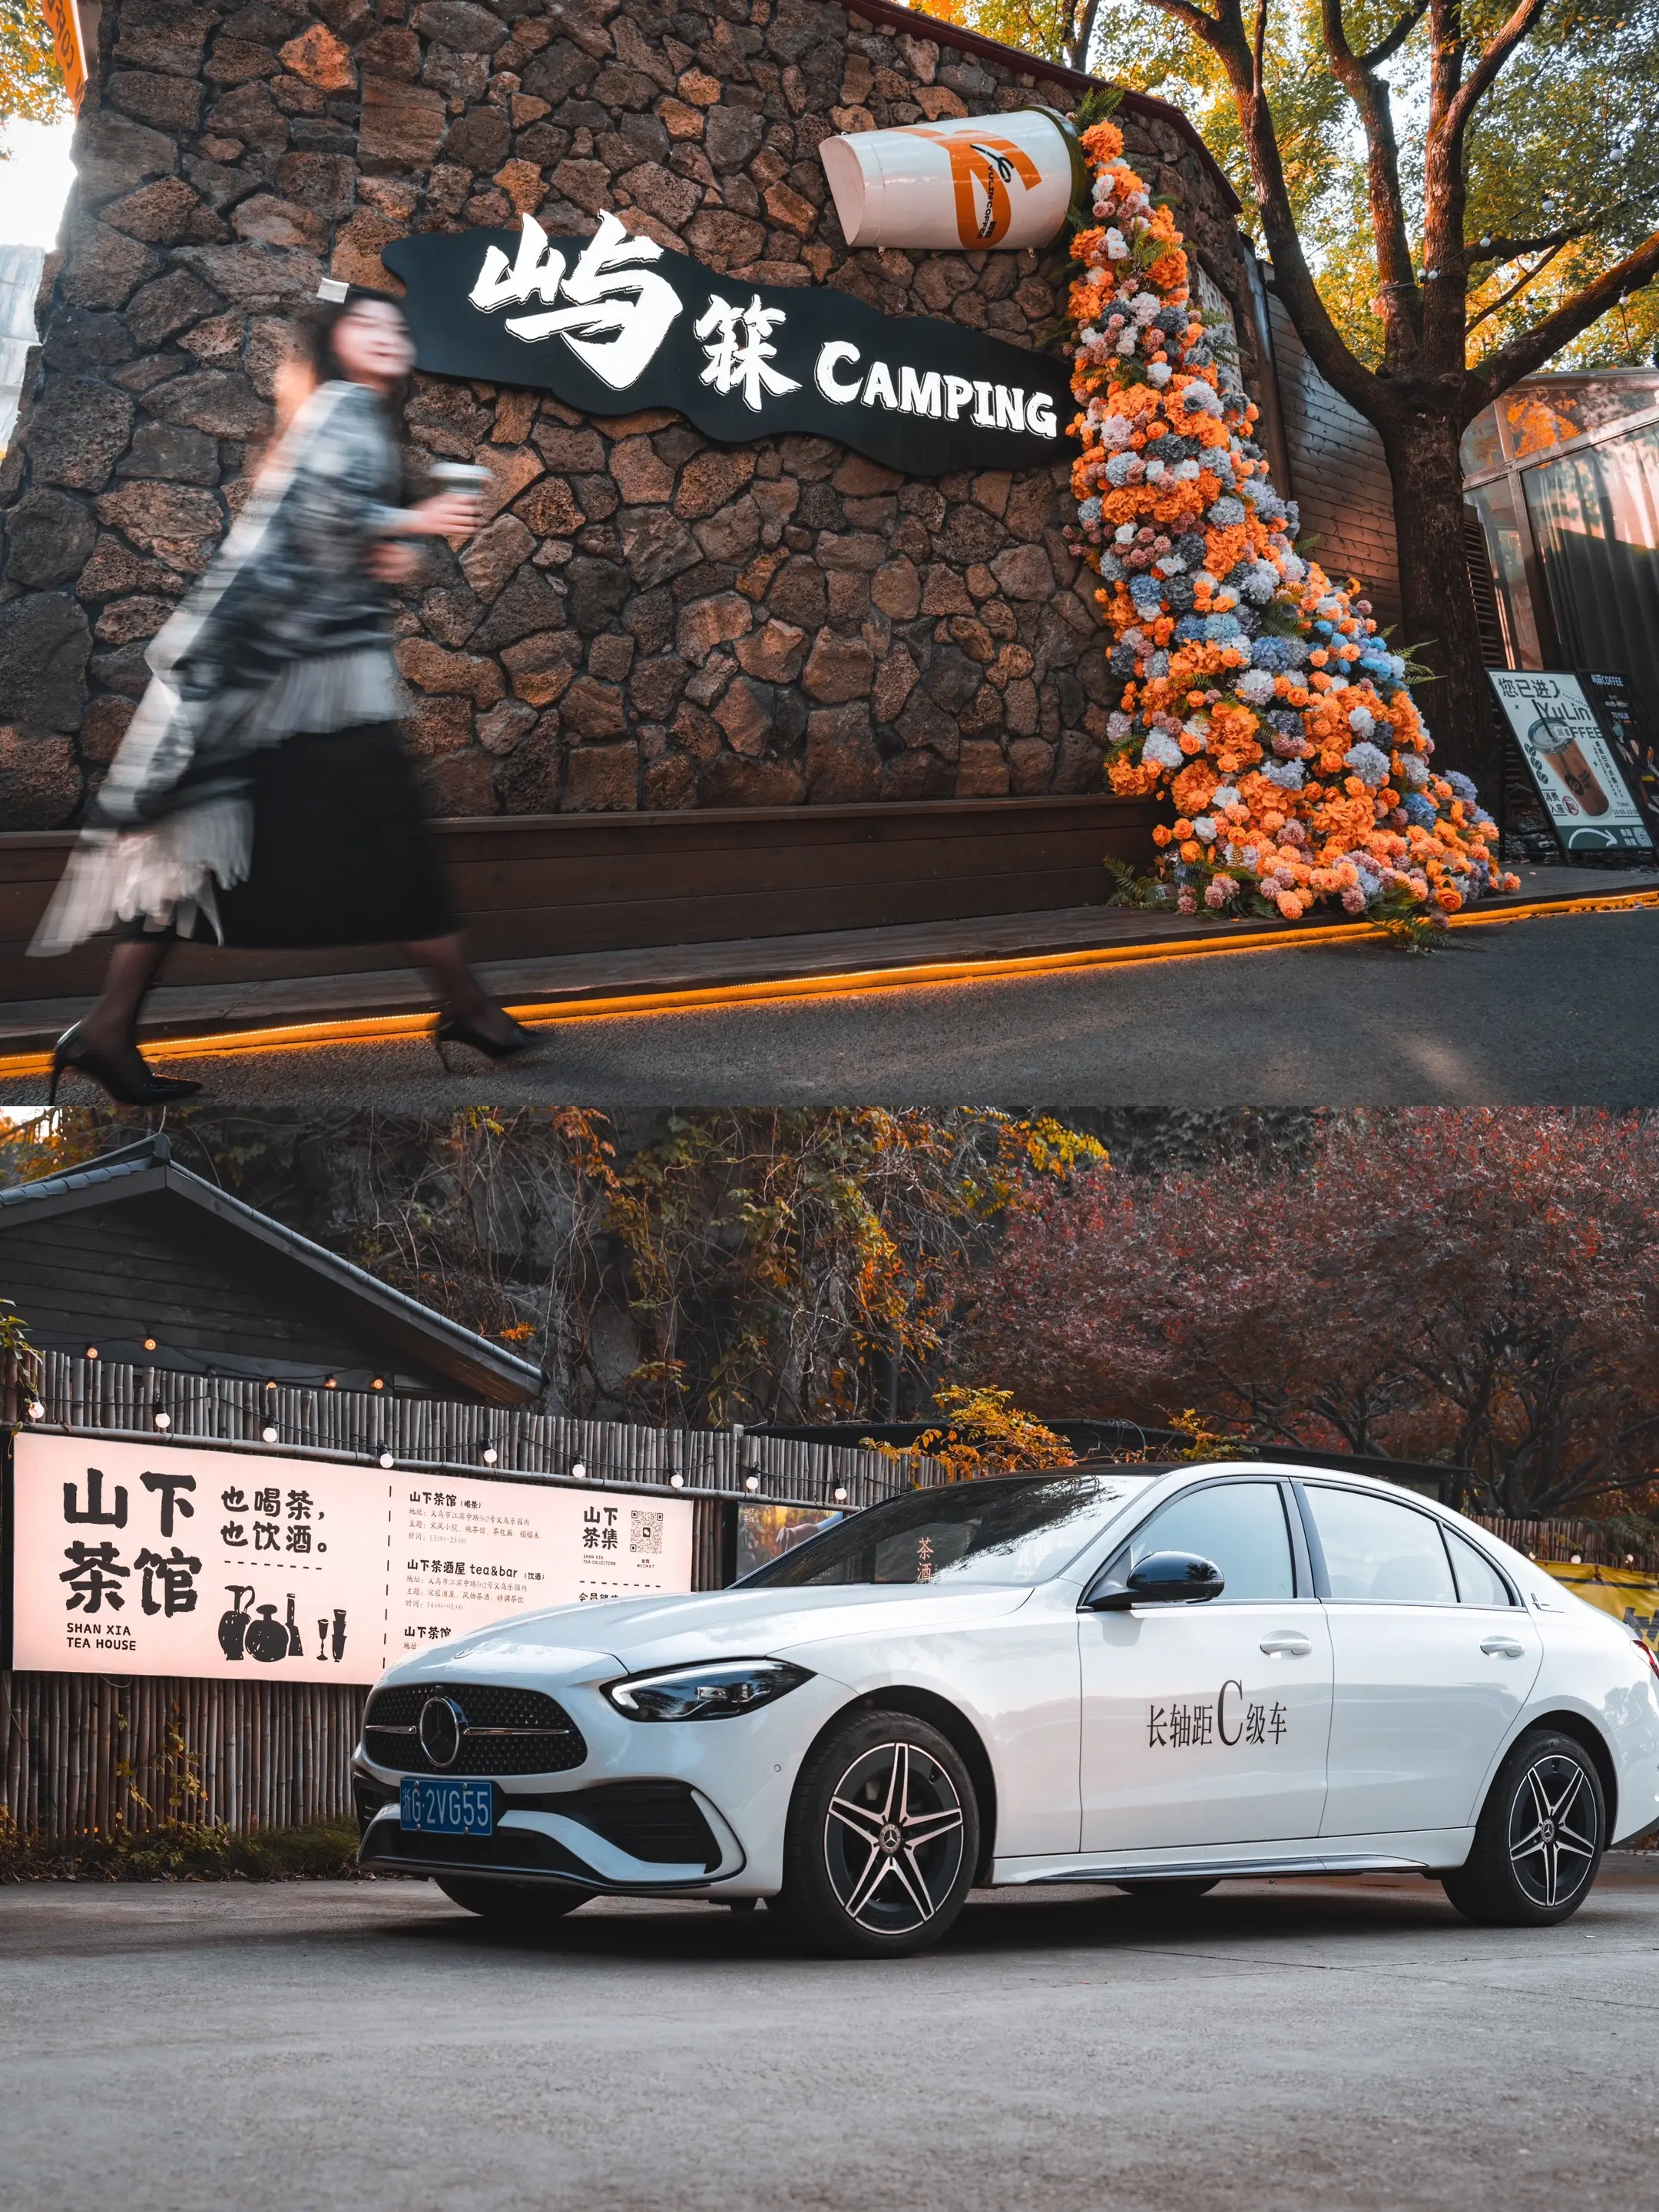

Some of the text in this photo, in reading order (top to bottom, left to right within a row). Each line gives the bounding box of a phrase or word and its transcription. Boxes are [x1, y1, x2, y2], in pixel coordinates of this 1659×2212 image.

[814, 340, 1058, 439] CAMPING
[1537, 701, 1592, 721] YuLin
[1555, 726, 1604, 739] COFFEE
[63, 1468, 197, 1538] 山下
[409, 1491, 457, 1507] 山下茶馆
[583, 1505, 618, 1527] 山下
[582, 1527, 618, 1551] 茶集
[407, 1558, 466, 1575] 山下茶酒屋
[469, 1564, 518, 1578] tea&bar
[59, 1540, 202, 1618] 茶馆
[66, 1622, 131, 1637] SHAN XIA
[66, 1637, 137, 1651] TEA HOUSE
[1146, 1679, 1287, 1748] 长轴距C级车
